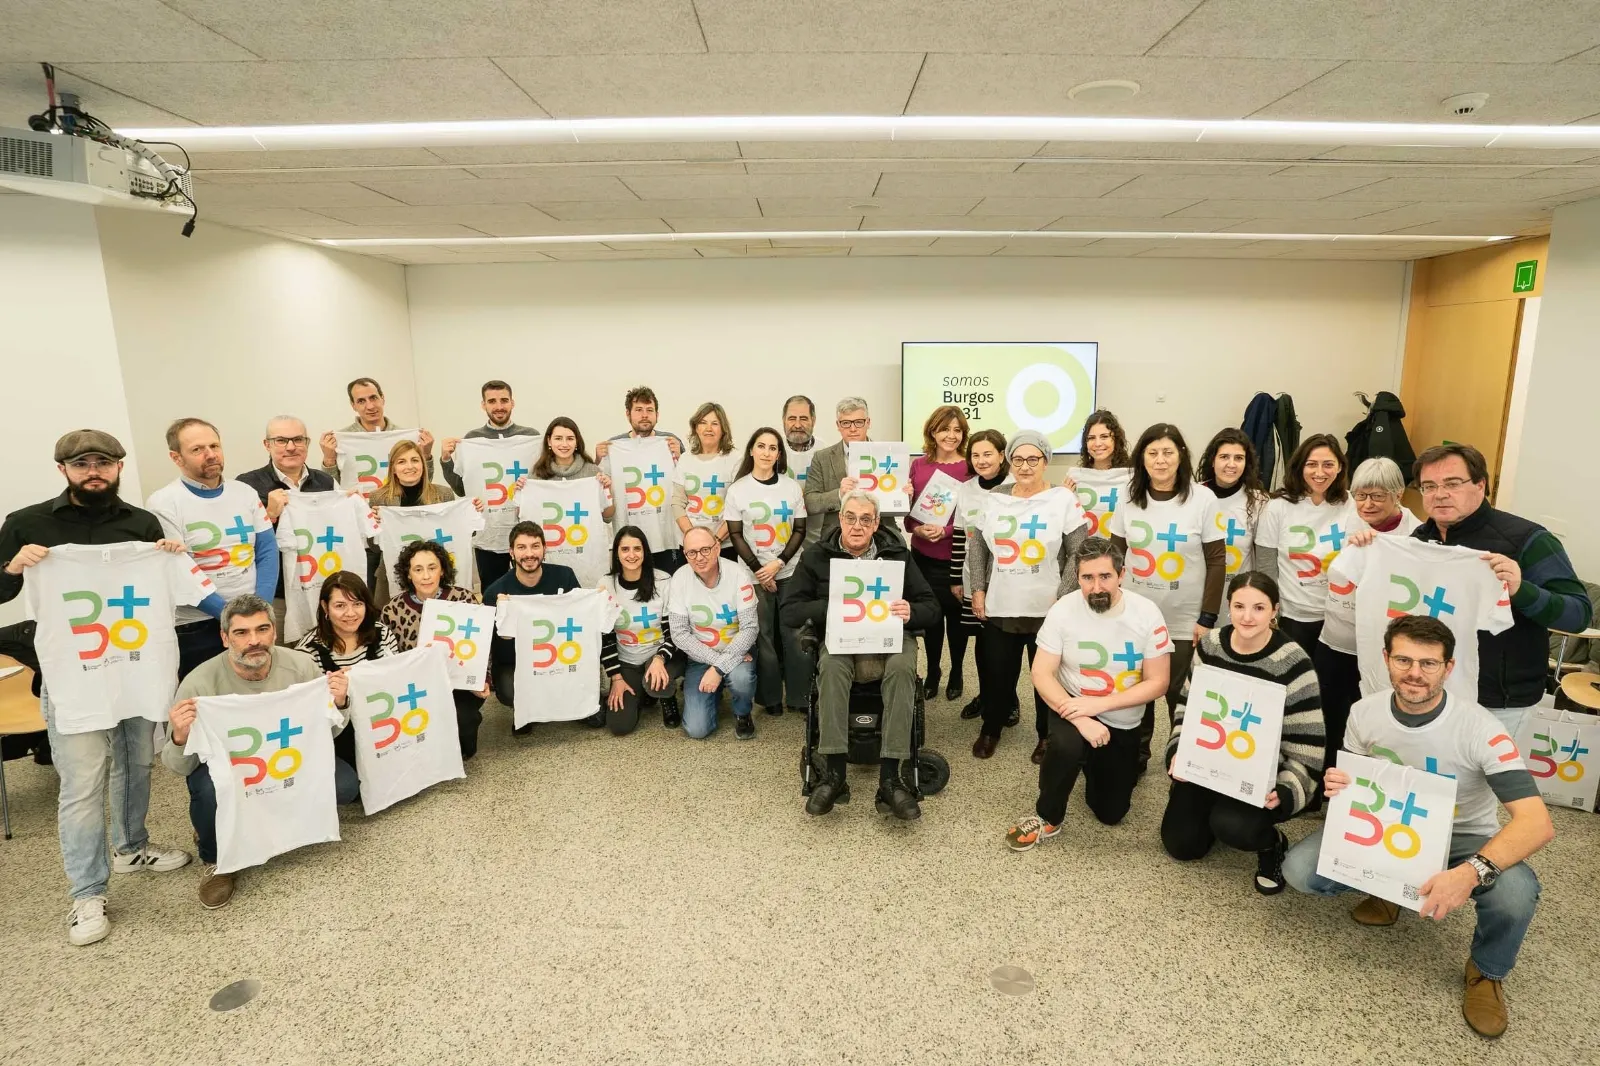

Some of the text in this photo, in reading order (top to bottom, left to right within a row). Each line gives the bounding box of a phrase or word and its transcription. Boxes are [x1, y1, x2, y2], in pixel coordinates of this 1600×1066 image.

[942, 376, 989, 387] somos
[943, 390, 994, 406] Burgos
[962, 407, 981, 419] 31
